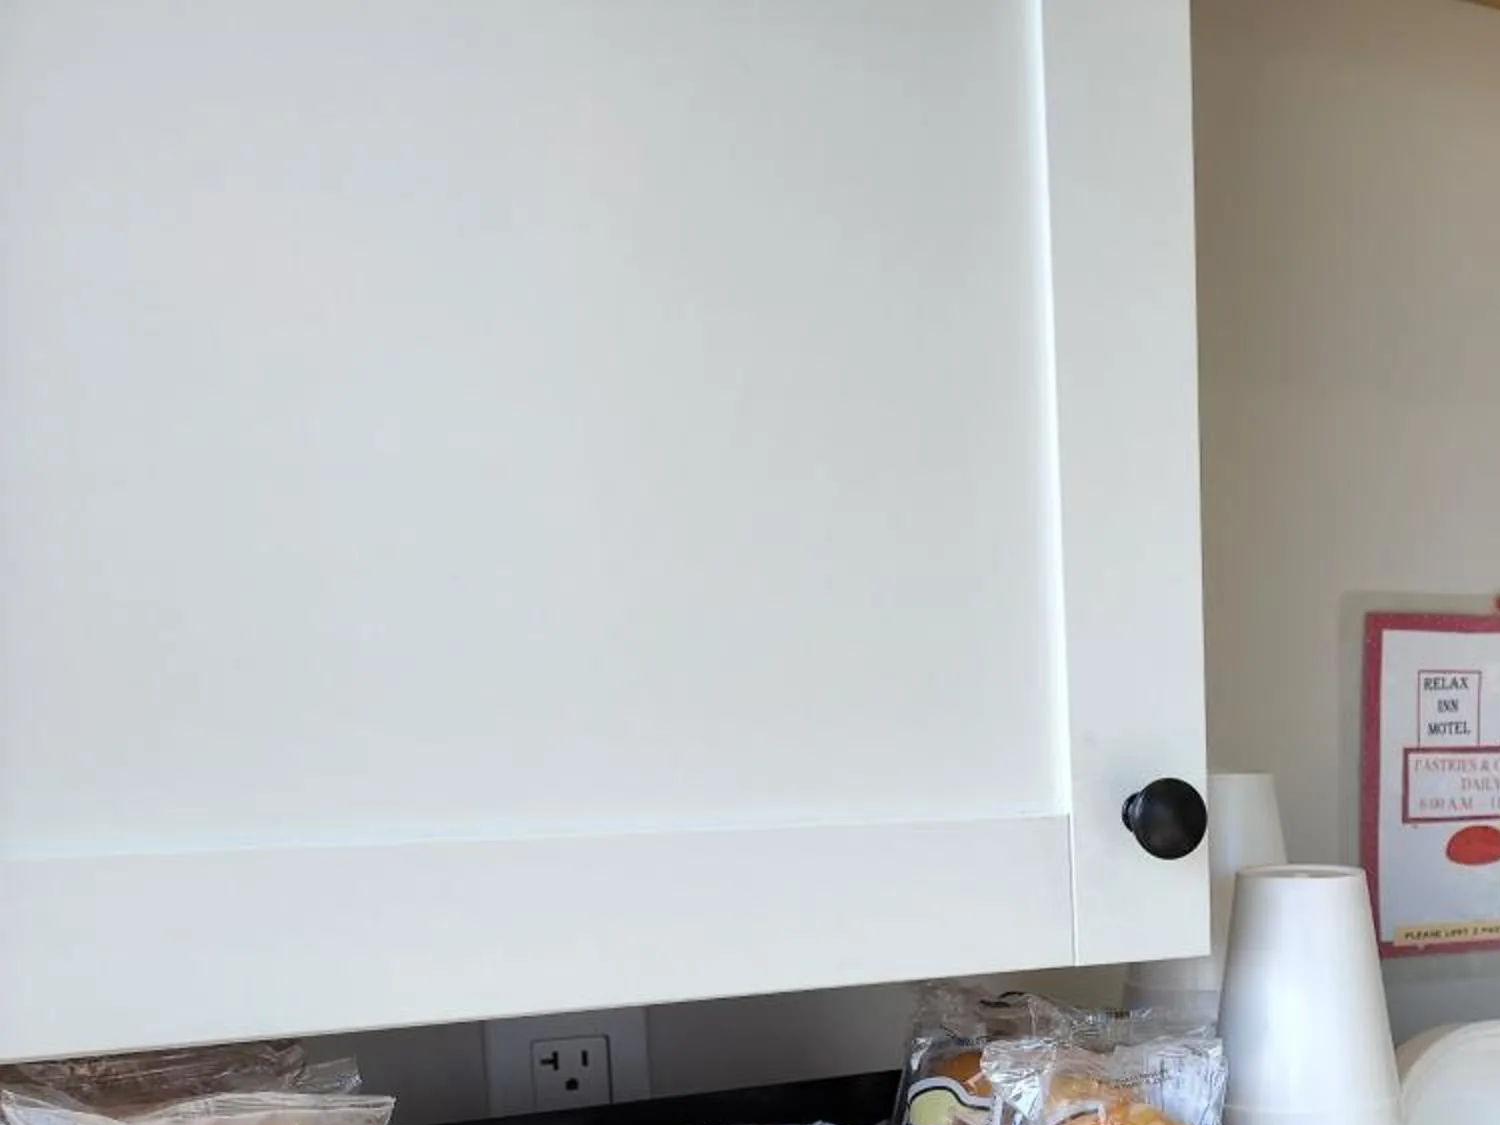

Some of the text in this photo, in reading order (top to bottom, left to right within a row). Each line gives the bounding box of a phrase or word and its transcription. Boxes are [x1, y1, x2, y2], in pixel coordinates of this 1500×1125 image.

[1423, 677, 1469, 691] RELAX
[1437, 700, 1459, 713] INN
[1427, 721, 1470, 736] MOTEL
